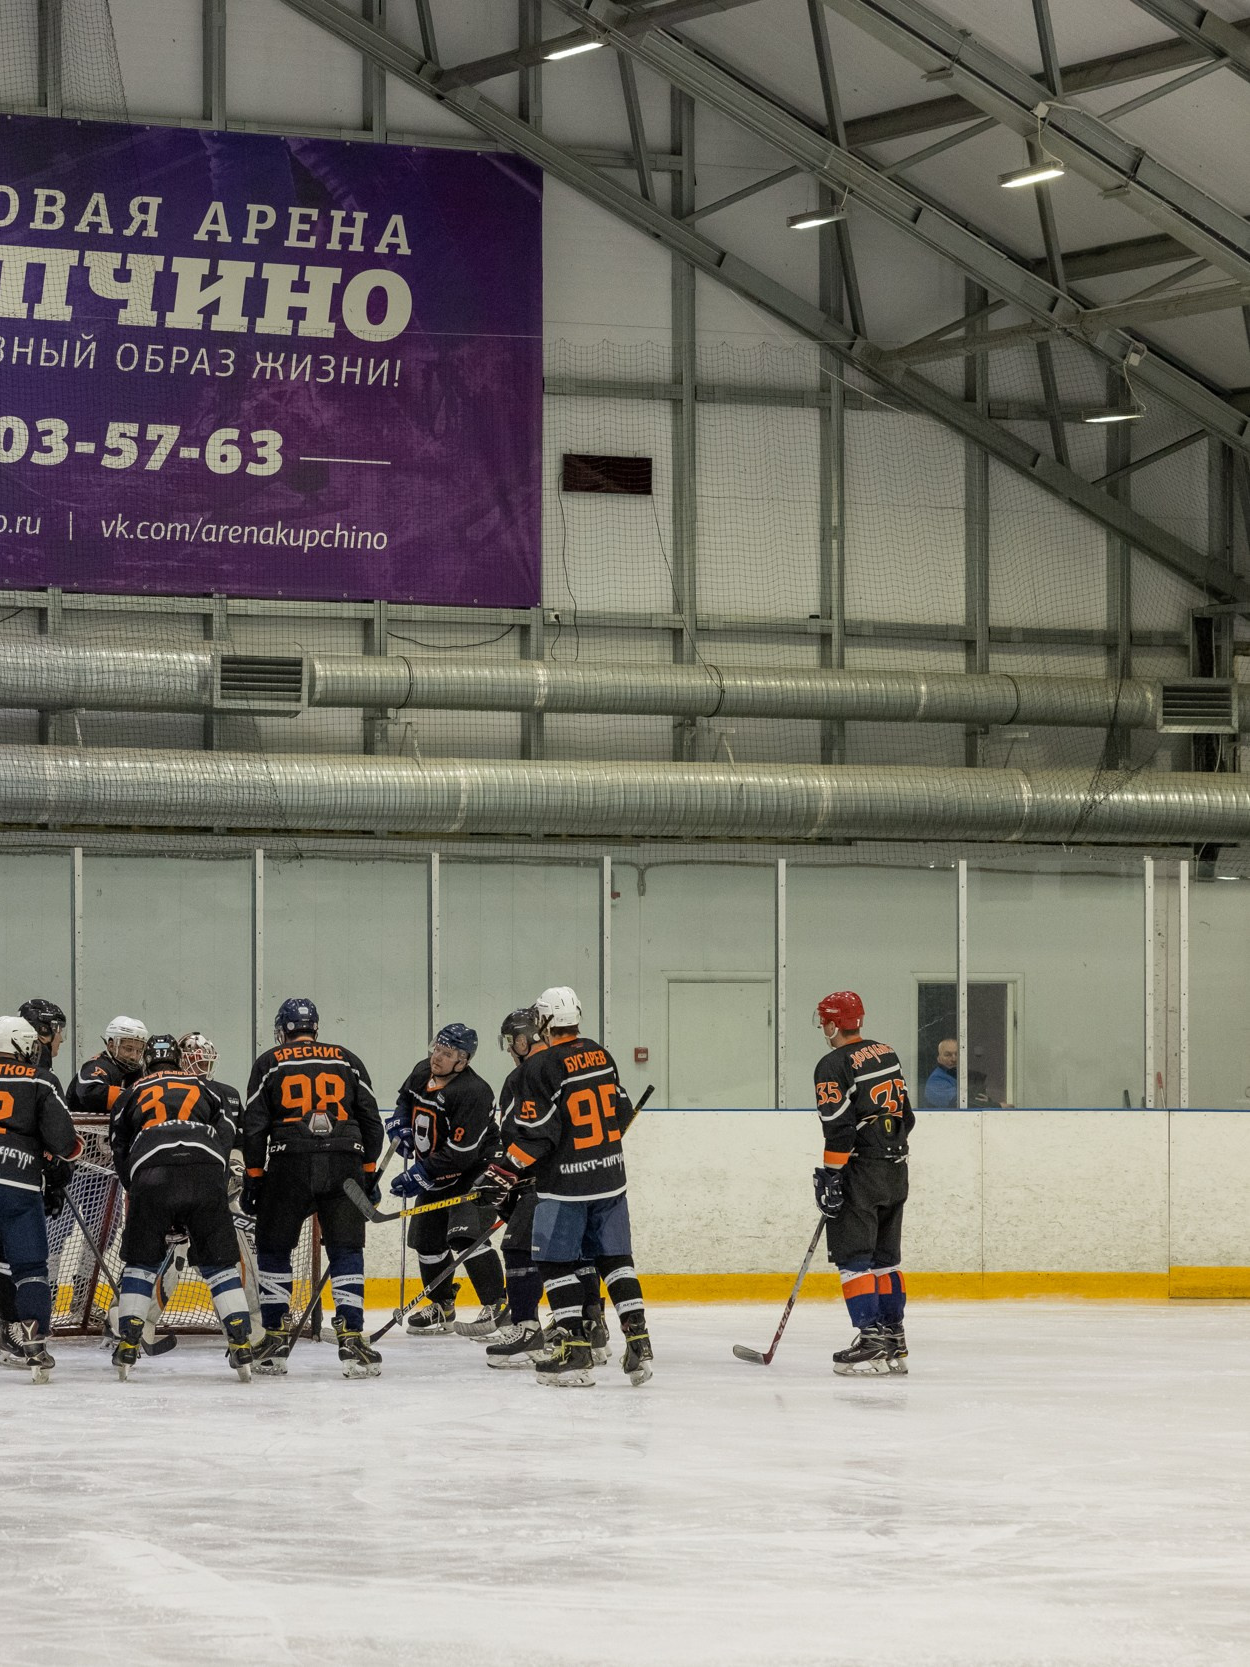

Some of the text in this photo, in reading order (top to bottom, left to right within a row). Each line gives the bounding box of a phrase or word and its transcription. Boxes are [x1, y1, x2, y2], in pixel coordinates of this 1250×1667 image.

[193, 201, 412, 255] АРЕНА
[115, 343, 237, 378] ОБРАЗ
[251, 351, 402, 388] ЖИЗНИ!
[100, 513, 389, 553] vk.com/arenakupchino
[155, 1049, 168, 1059] 37
[273, 1045, 344, 1062] БРЕСКИС
[563, 1049, 608, 1073] БУСАРЕВ
[137, 1082, 201, 1131] 37
[281, 1071, 349, 1123] 98
[815, 1081, 843, 1106] 35
[453, 1126, 465, 1142] 8
[566, 1083, 622, 1151] 95
